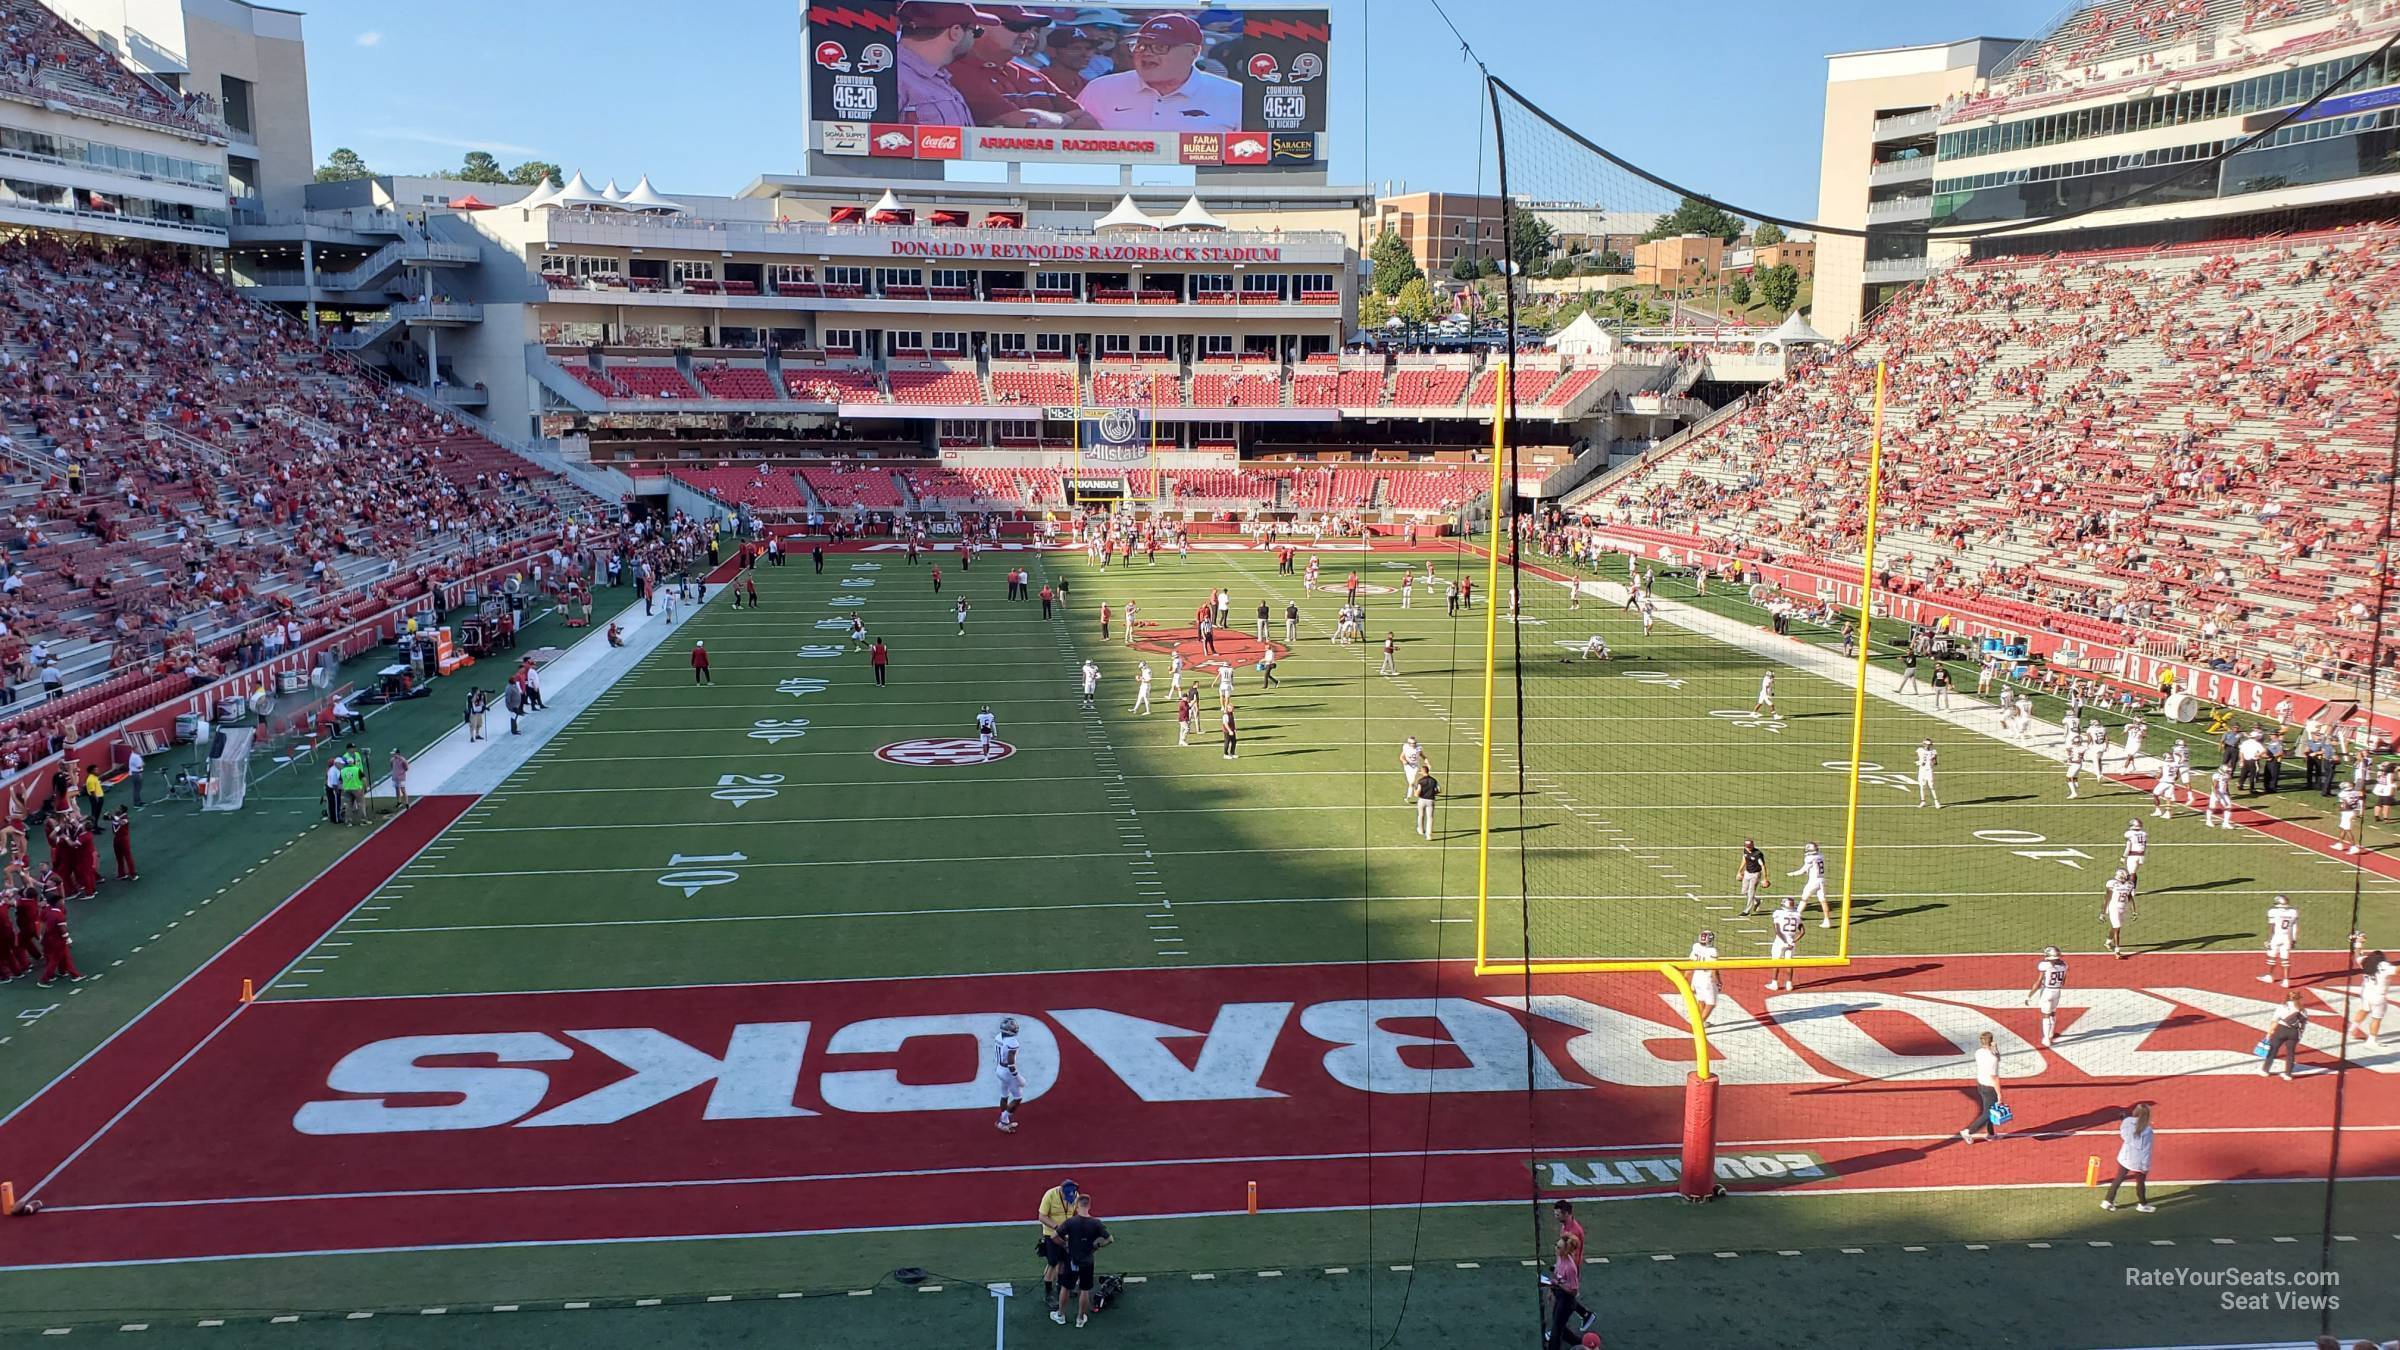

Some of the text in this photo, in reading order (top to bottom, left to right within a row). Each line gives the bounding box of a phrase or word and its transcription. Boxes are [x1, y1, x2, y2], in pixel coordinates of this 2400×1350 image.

[835, 75, 874, 85] COUNTDOWN
[835, 86, 875, 108] 46:20
[1266, 86, 1303, 95] COUNTDOWN
[839, 111, 872, 120] TO KICKOFF
[1265, 97, 1303, 118] 46:20
[1267, 120, 1301, 129] TO KICKOFF
[979, 136, 1155, 153] ARKANSAS RAZORBACKS
[1193, 135, 1218, 144] FARM
[1273, 138, 1312, 150] SARACEN
[1183, 144, 1219, 153] BUREAU
[891, 240, 1281, 262] DONALD W REYNOLDS RAZORBACK STADIUM
[1089, 443, 1146, 461] Allstate
[1067, 480, 1119, 489] ARKANSAS
[776, 677, 830, 693] 40
[746, 718, 810, 740] 30
[711, 773, 785, 801] 20
[656, 851, 748, 887] 10
[1782, 917, 1798, 933] 23
[2050, 970, 2067, 988] 84
